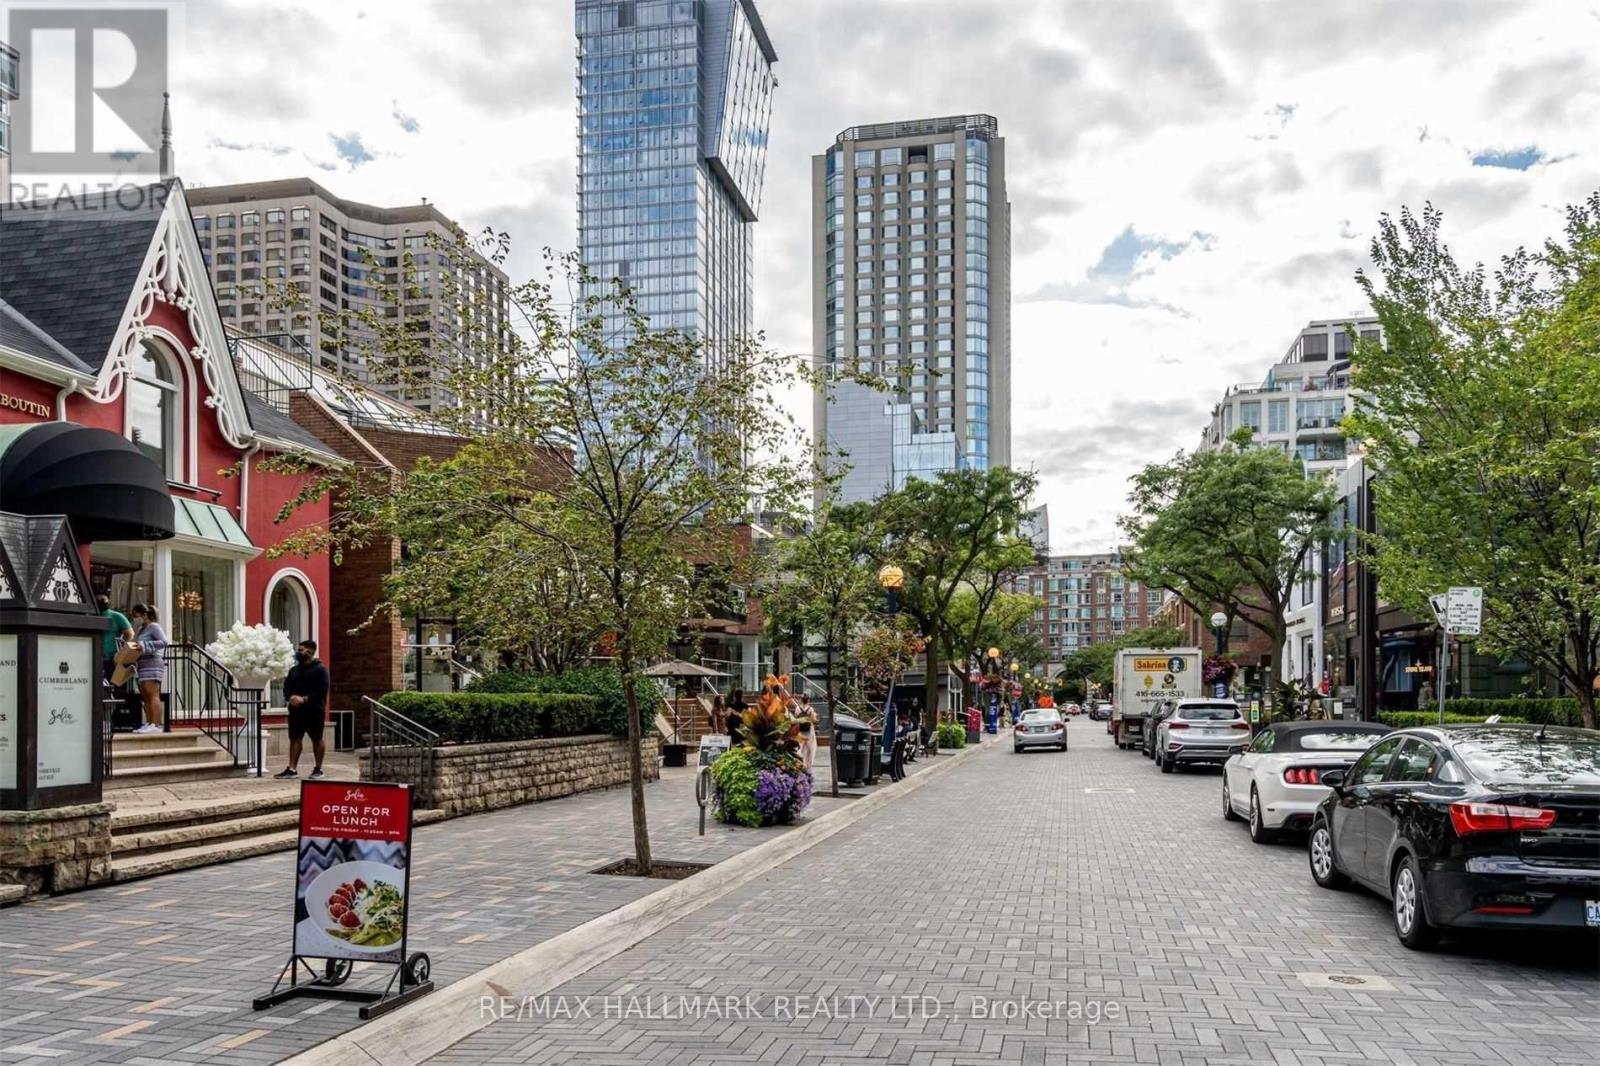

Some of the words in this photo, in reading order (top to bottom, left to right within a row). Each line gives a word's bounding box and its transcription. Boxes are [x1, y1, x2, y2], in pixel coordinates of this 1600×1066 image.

[0, 393, 51, 418] BOUTIN
[1136, 660, 1167, 669] Sabrina
[322, 804, 358, 815] OPEN
[363, 806, 390, 816] FOR
[333, 815, 378, 826] LUNCH
